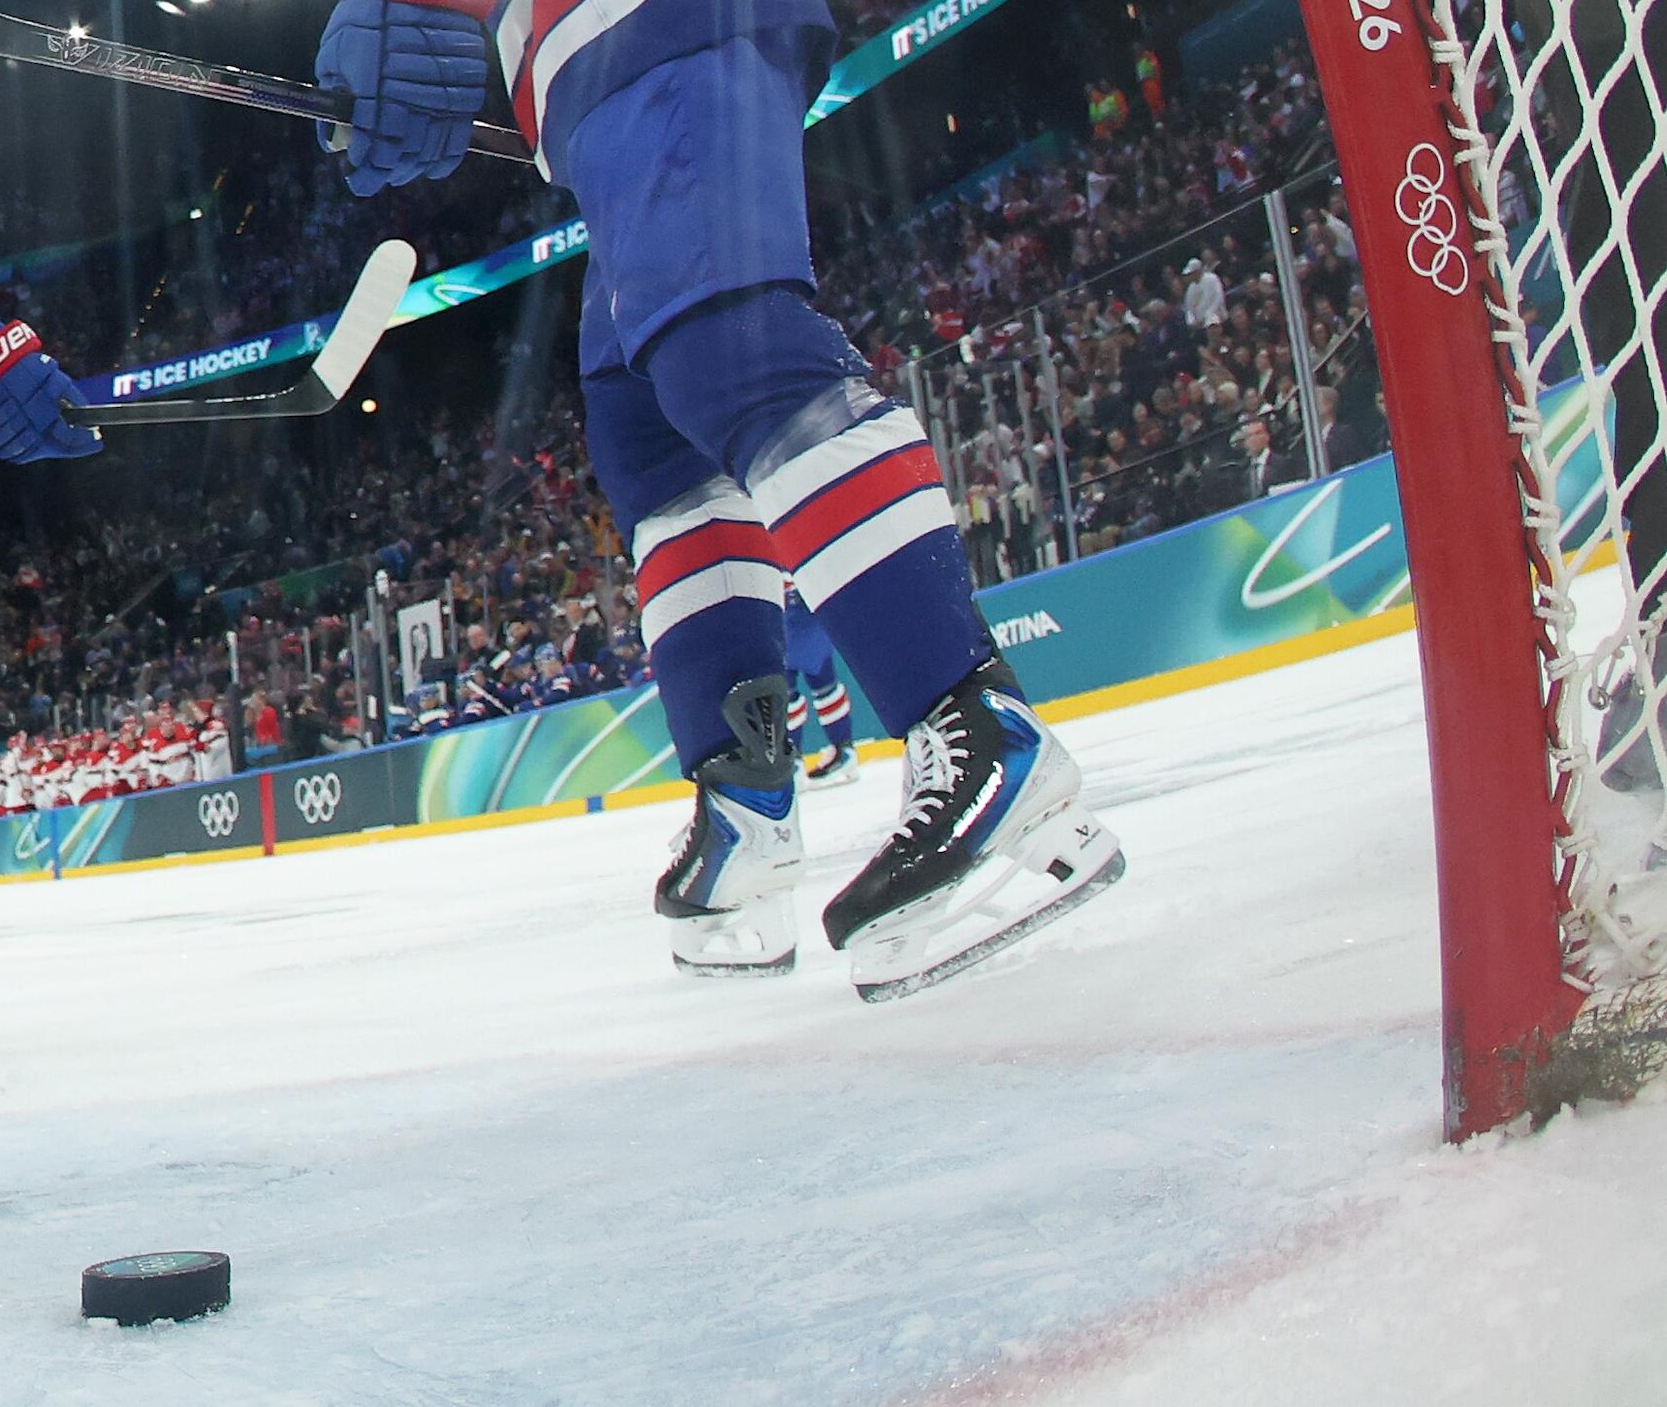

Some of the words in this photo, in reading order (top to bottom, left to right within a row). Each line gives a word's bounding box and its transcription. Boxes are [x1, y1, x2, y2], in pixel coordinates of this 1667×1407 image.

[892, 17, 928, 60] IT'S
[532, 229, 566, 264] IT'S
[113, 369, 153, 397] IT'S
[154, 361, 187, 388] ICE
[189, 338, 271, 379] HOCKEY
[989, 609, 1062, 649] RTINA
